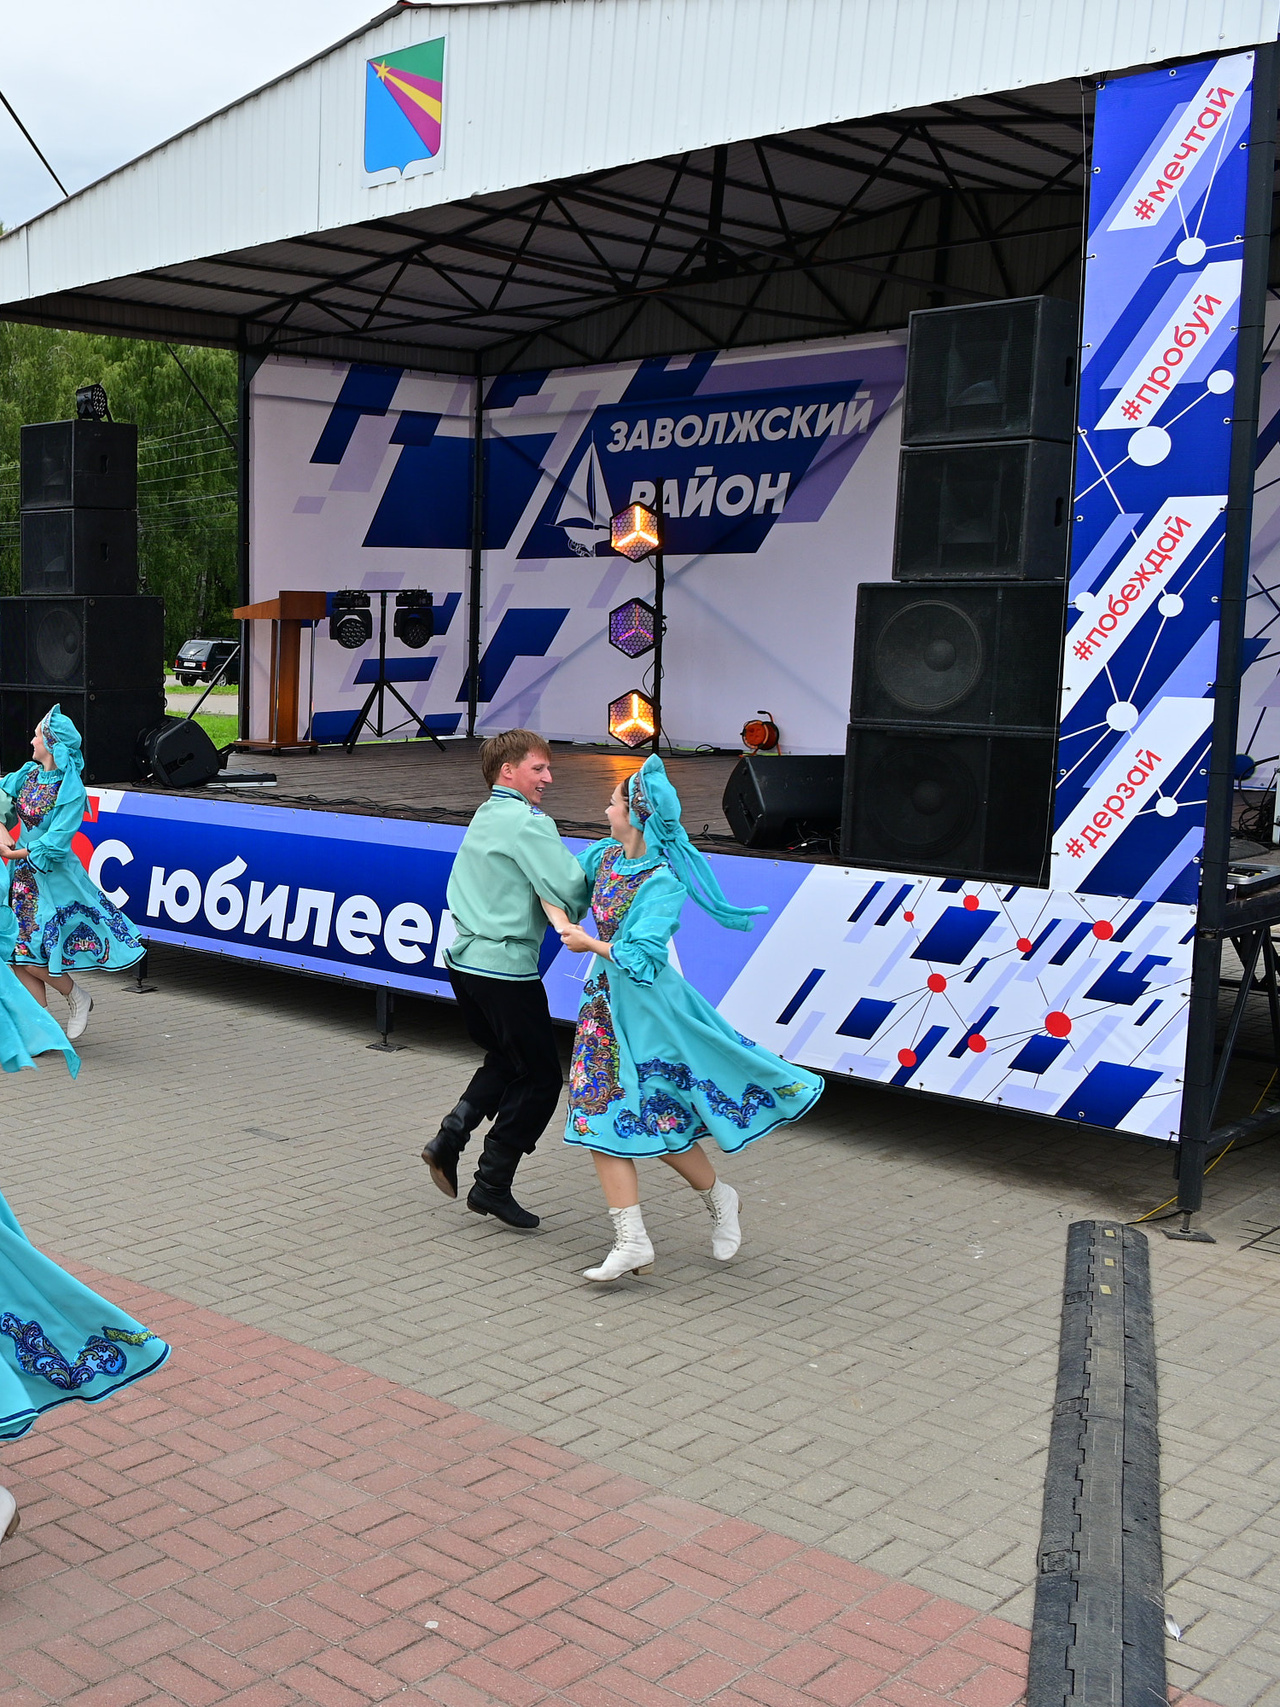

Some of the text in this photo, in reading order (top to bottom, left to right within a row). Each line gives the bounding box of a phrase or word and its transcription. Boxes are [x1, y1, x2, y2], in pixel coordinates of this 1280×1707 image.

[1134, 87, 1235, 220] #мечтай
[1121, 293, 1223, 421] #пробуй
[606, 390, 874, 452] ЗАВОЛЖСКИЙ
[1072, 515, 1193, 662] #побеждай
[1065, 748, 1163, 859] #дерзай
[88, 839, 134, 909] С
